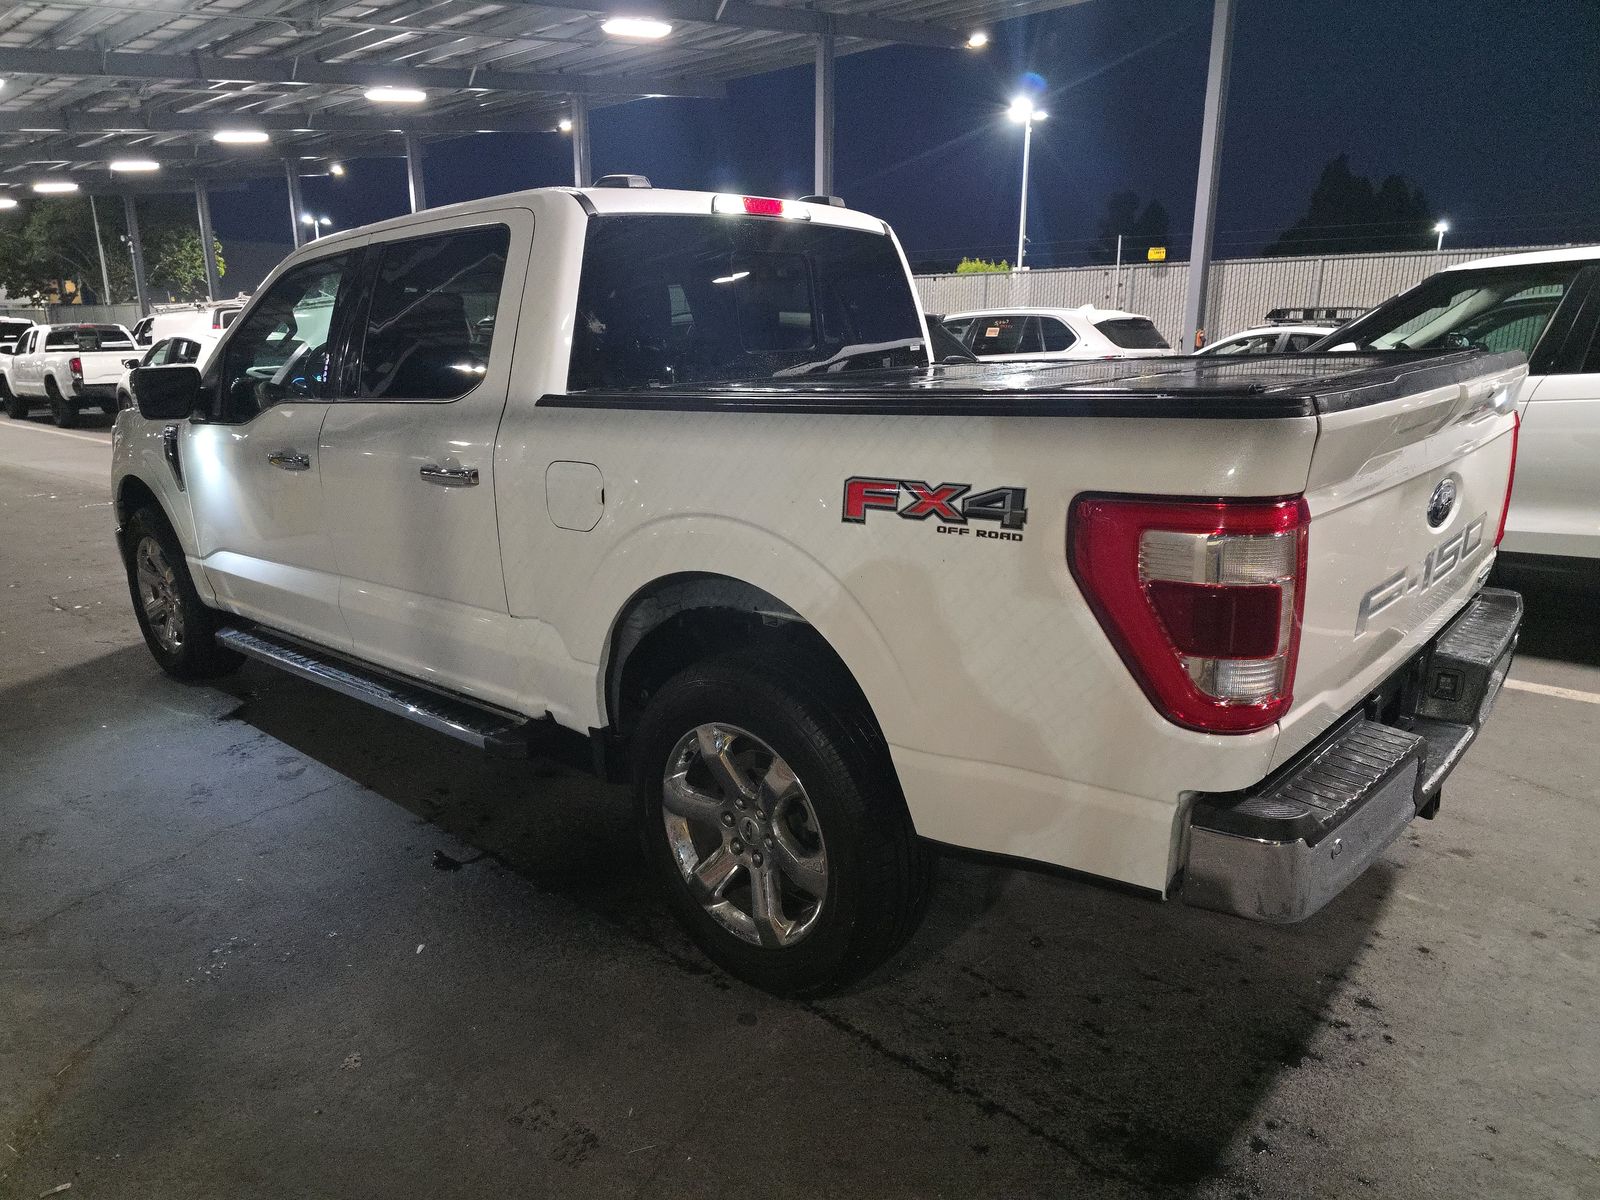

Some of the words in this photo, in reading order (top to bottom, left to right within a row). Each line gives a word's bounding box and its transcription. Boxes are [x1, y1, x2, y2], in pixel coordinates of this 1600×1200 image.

[841, 476, 1027, 531] FX4
[936, 525, 970, 536] OFF
[976, 529, 1024, 542] ROAD
[1353, 511, 1488, 641] F-150
